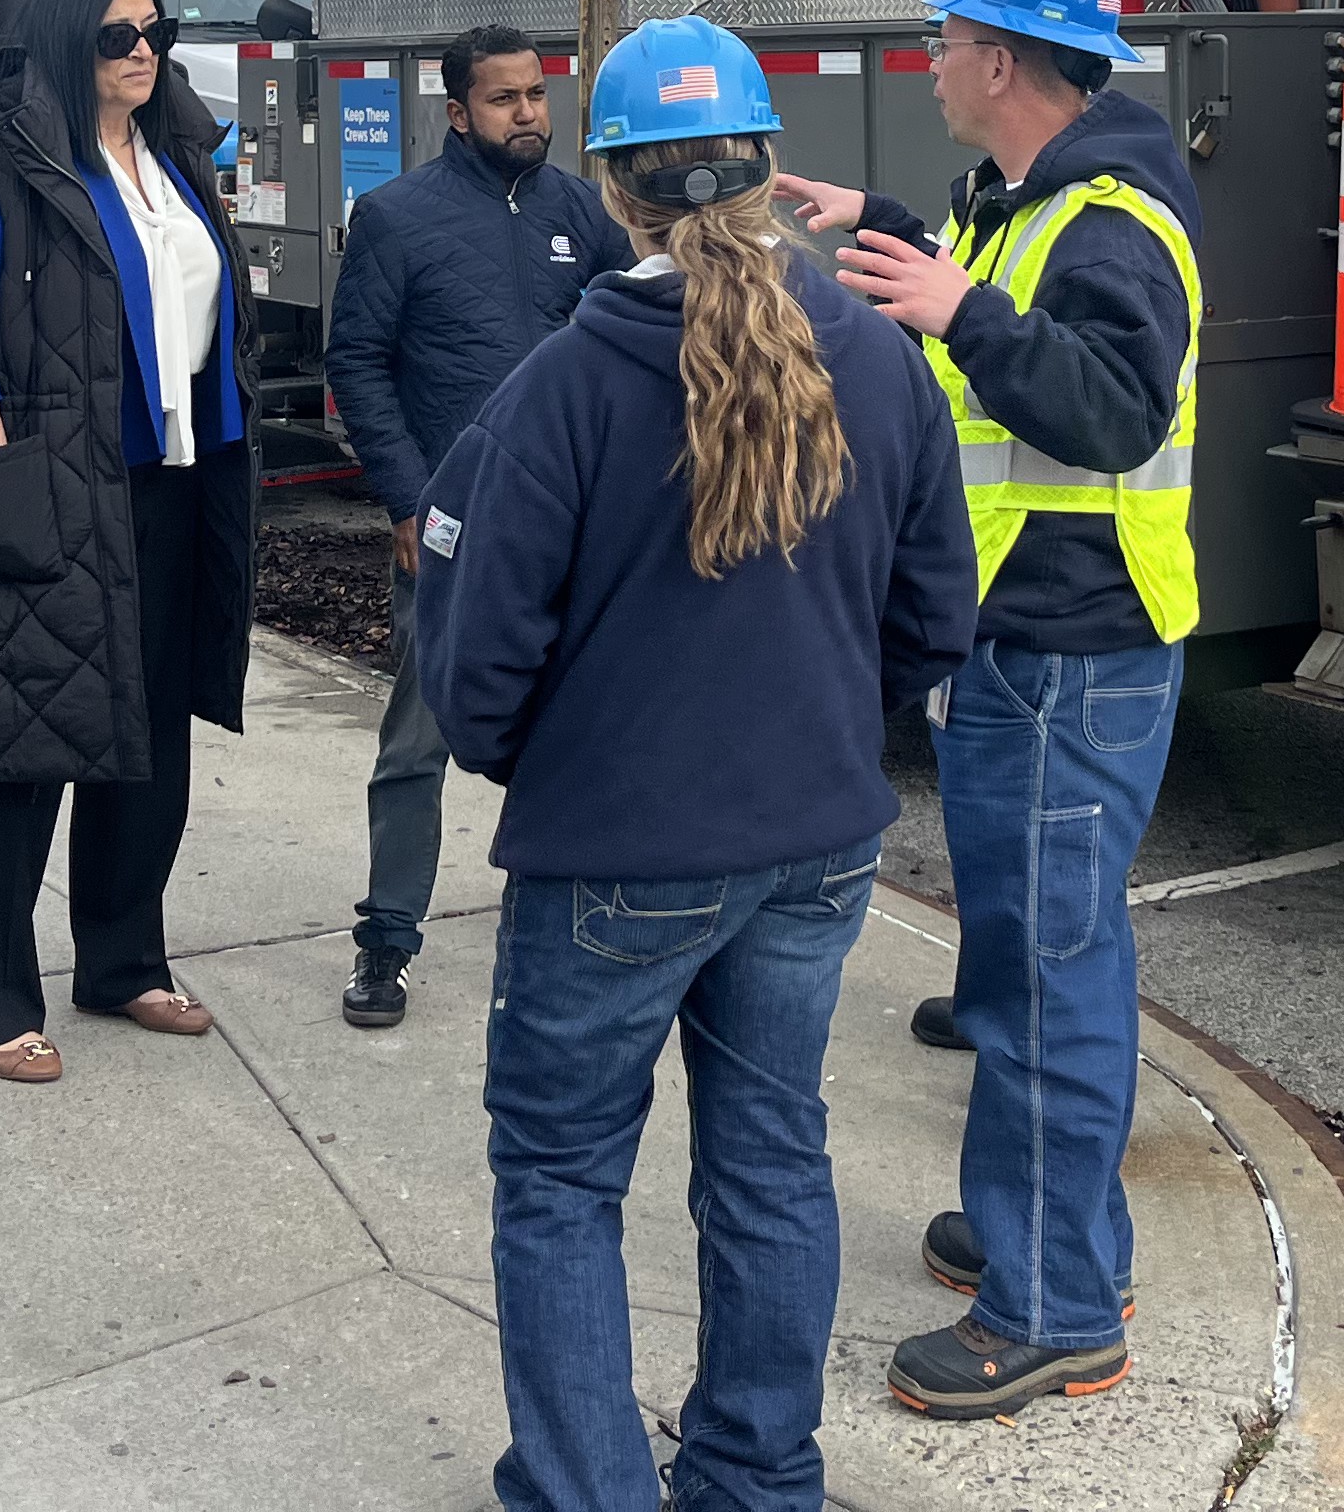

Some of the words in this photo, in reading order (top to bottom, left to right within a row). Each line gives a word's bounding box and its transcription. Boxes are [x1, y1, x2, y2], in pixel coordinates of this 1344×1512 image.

[343, 107, 365, 125] Keep
[366, 107, 390, 123] These
[344, 127, 368, 143] Crews
[369, 127, 389, 144] Safe
